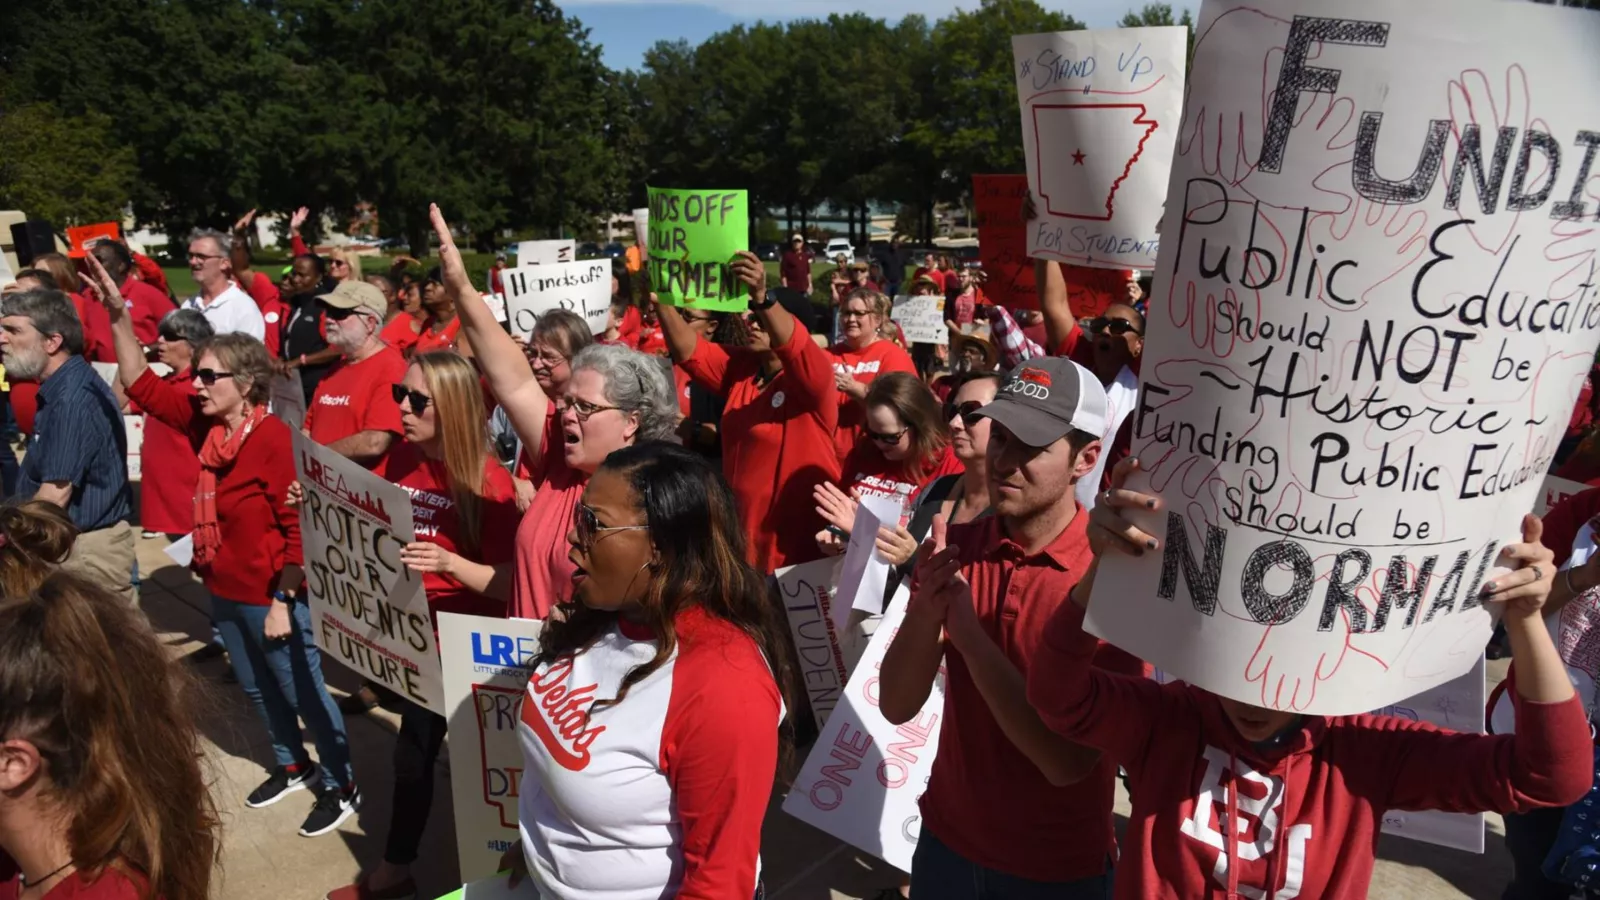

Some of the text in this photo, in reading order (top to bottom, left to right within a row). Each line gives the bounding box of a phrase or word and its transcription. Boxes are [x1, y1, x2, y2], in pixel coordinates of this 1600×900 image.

[1117, 42, 1153, 83] UP
[1258, 15, 1600, 222] FUNDI
[684, 193, 738, 226] OFF
[1036, 221, 1063, 250] FOR
[510, 265, 603, 297] Hands off
[1174, 178, 1600, 333] Public Educatio
[1352, 319, 1477, 392] NOT
[1491, 338, 1531, 382] be
[1136, 382, 1279, 494] Funding
[1310, 432, 1440, 493] Public
[301, 483, 413, 581] PROTECT
[1393, 508, 1431, 539] be
[326, 545, 388, 597] OUR
[1157, 511, 1499, 634] NORMAL
[322, 619, 429, 704] FUTURE
[471, 632, 535, 668] LRE
[473, 665, 499, 674] LITTLE
[501, 667, 525, 679] ROCK
[809, 722, 874, 812] ONE
[876, 710, 939, 789] ONE
[487, 767, 523, 797] DI
